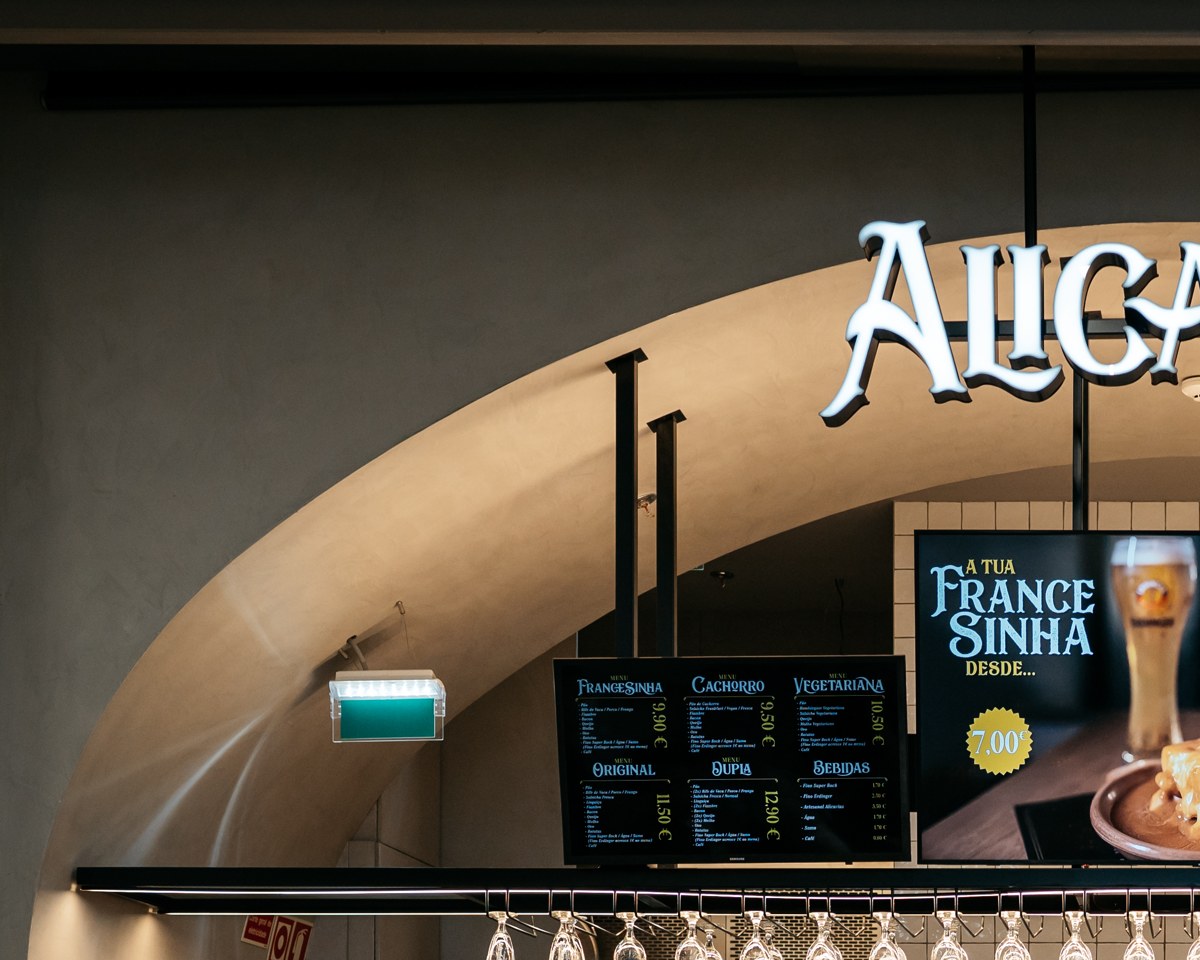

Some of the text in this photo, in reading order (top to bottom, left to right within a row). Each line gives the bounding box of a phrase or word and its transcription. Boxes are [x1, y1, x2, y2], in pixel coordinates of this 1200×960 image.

[966, 559, 1015, 575] A TUA
[930, 565, 1095, 618] FRANCE
[949, 611, 1094, 658] SINHA
[965, 661, 1036, 677] DESDE...
[577, 679, 663, 696] FRANCESINHA
[692, 676, 765, 694] CACHORRO
[794, 676, 885, 694] VEGETARIANA
[652, 703, 667, 731] 9.90
[760, 702, 775, 730] 9.50
[871, 701, 884, 731] 10.50
[593, 762, 656, 777] ORIGINAL
[712, 761, 752, 776] DUPLA
[813, 760, 870, 776] BEBIDAS
[657, 794, 671, 824] 11.50
[765, 791, 780, 824] 12.90
